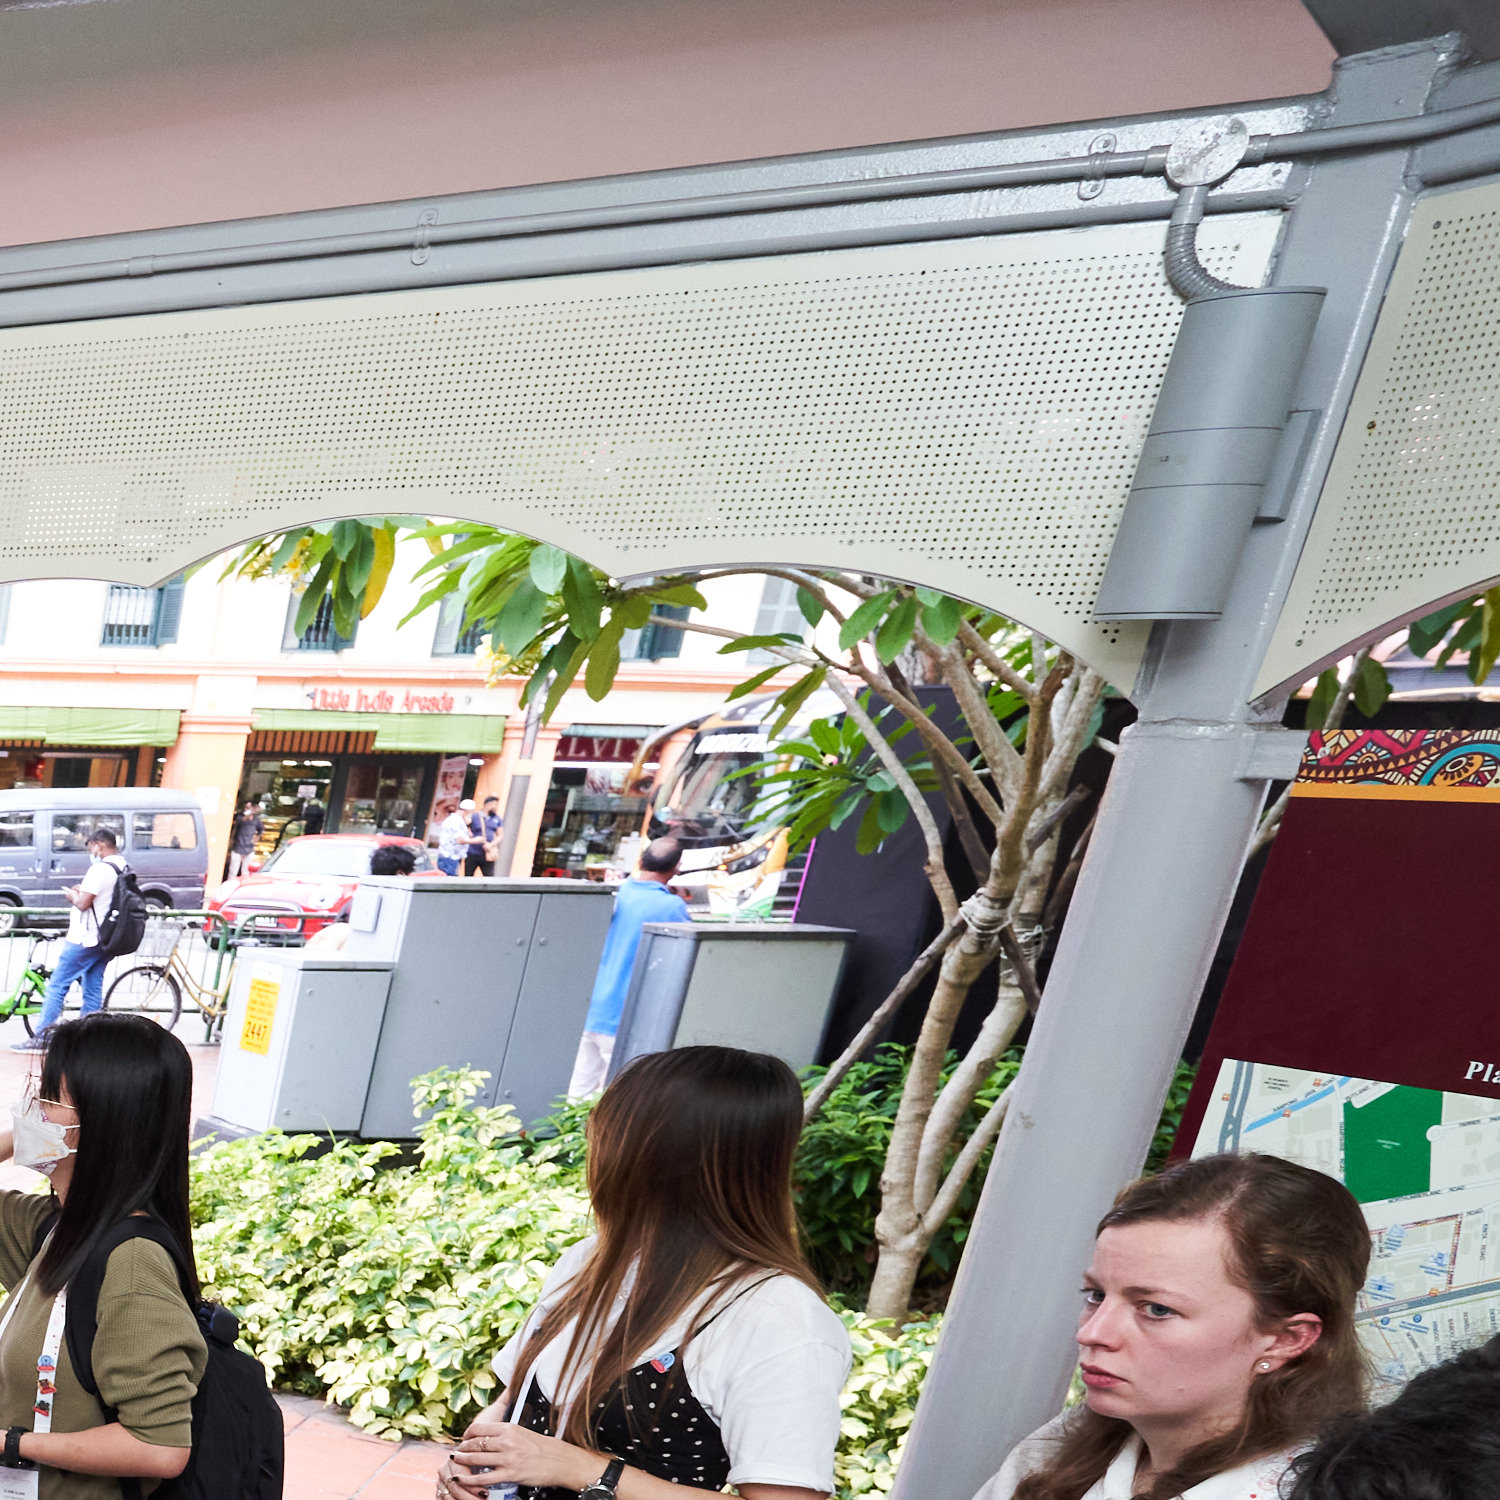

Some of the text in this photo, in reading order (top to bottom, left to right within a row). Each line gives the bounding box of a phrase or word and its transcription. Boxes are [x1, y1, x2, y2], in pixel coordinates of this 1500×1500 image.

[312, 688, 454, 712] Little India Arcade
